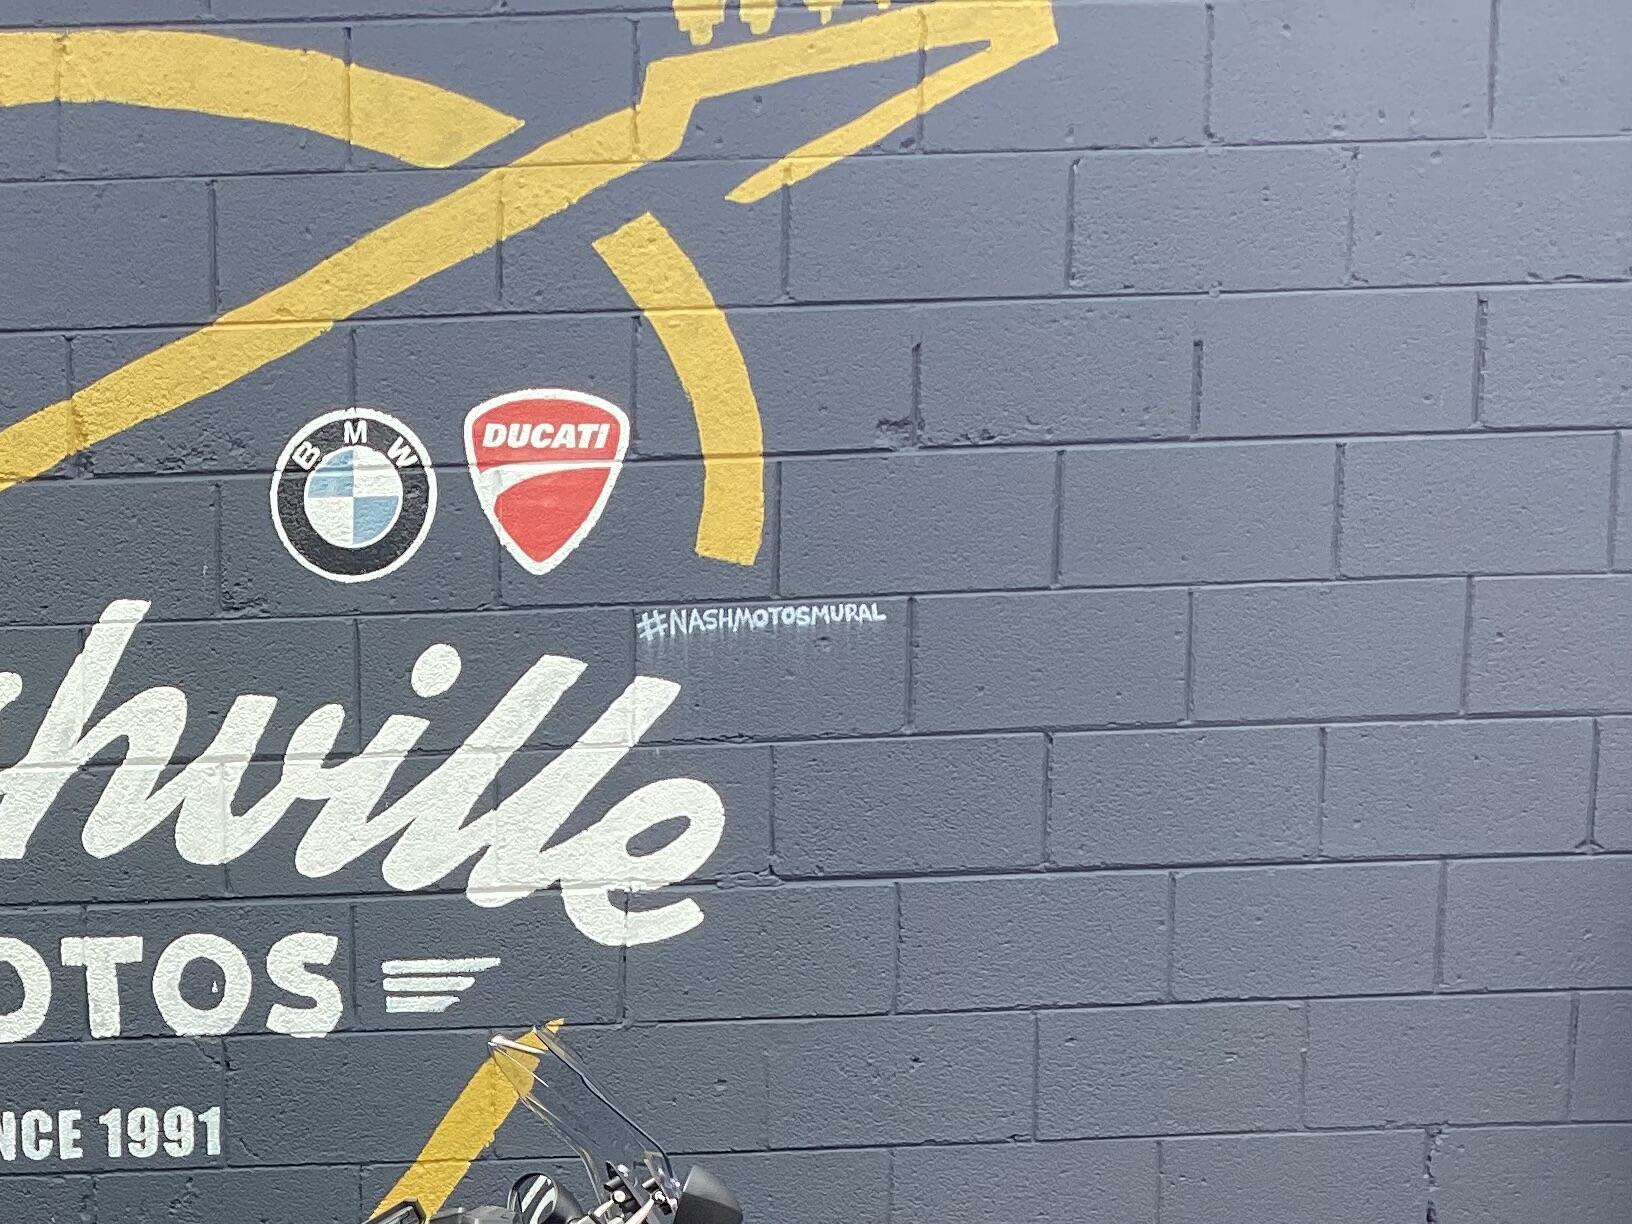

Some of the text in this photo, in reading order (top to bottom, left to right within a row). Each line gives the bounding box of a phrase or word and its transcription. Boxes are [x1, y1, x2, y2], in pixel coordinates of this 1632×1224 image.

[292, 420, 418, 470] BMW
[482, 422, 610, 449] DUCATI
[636, 602, 887, 641] #NASHMOTOSMURAL
[98, 1105, 221, 1158] 1991
